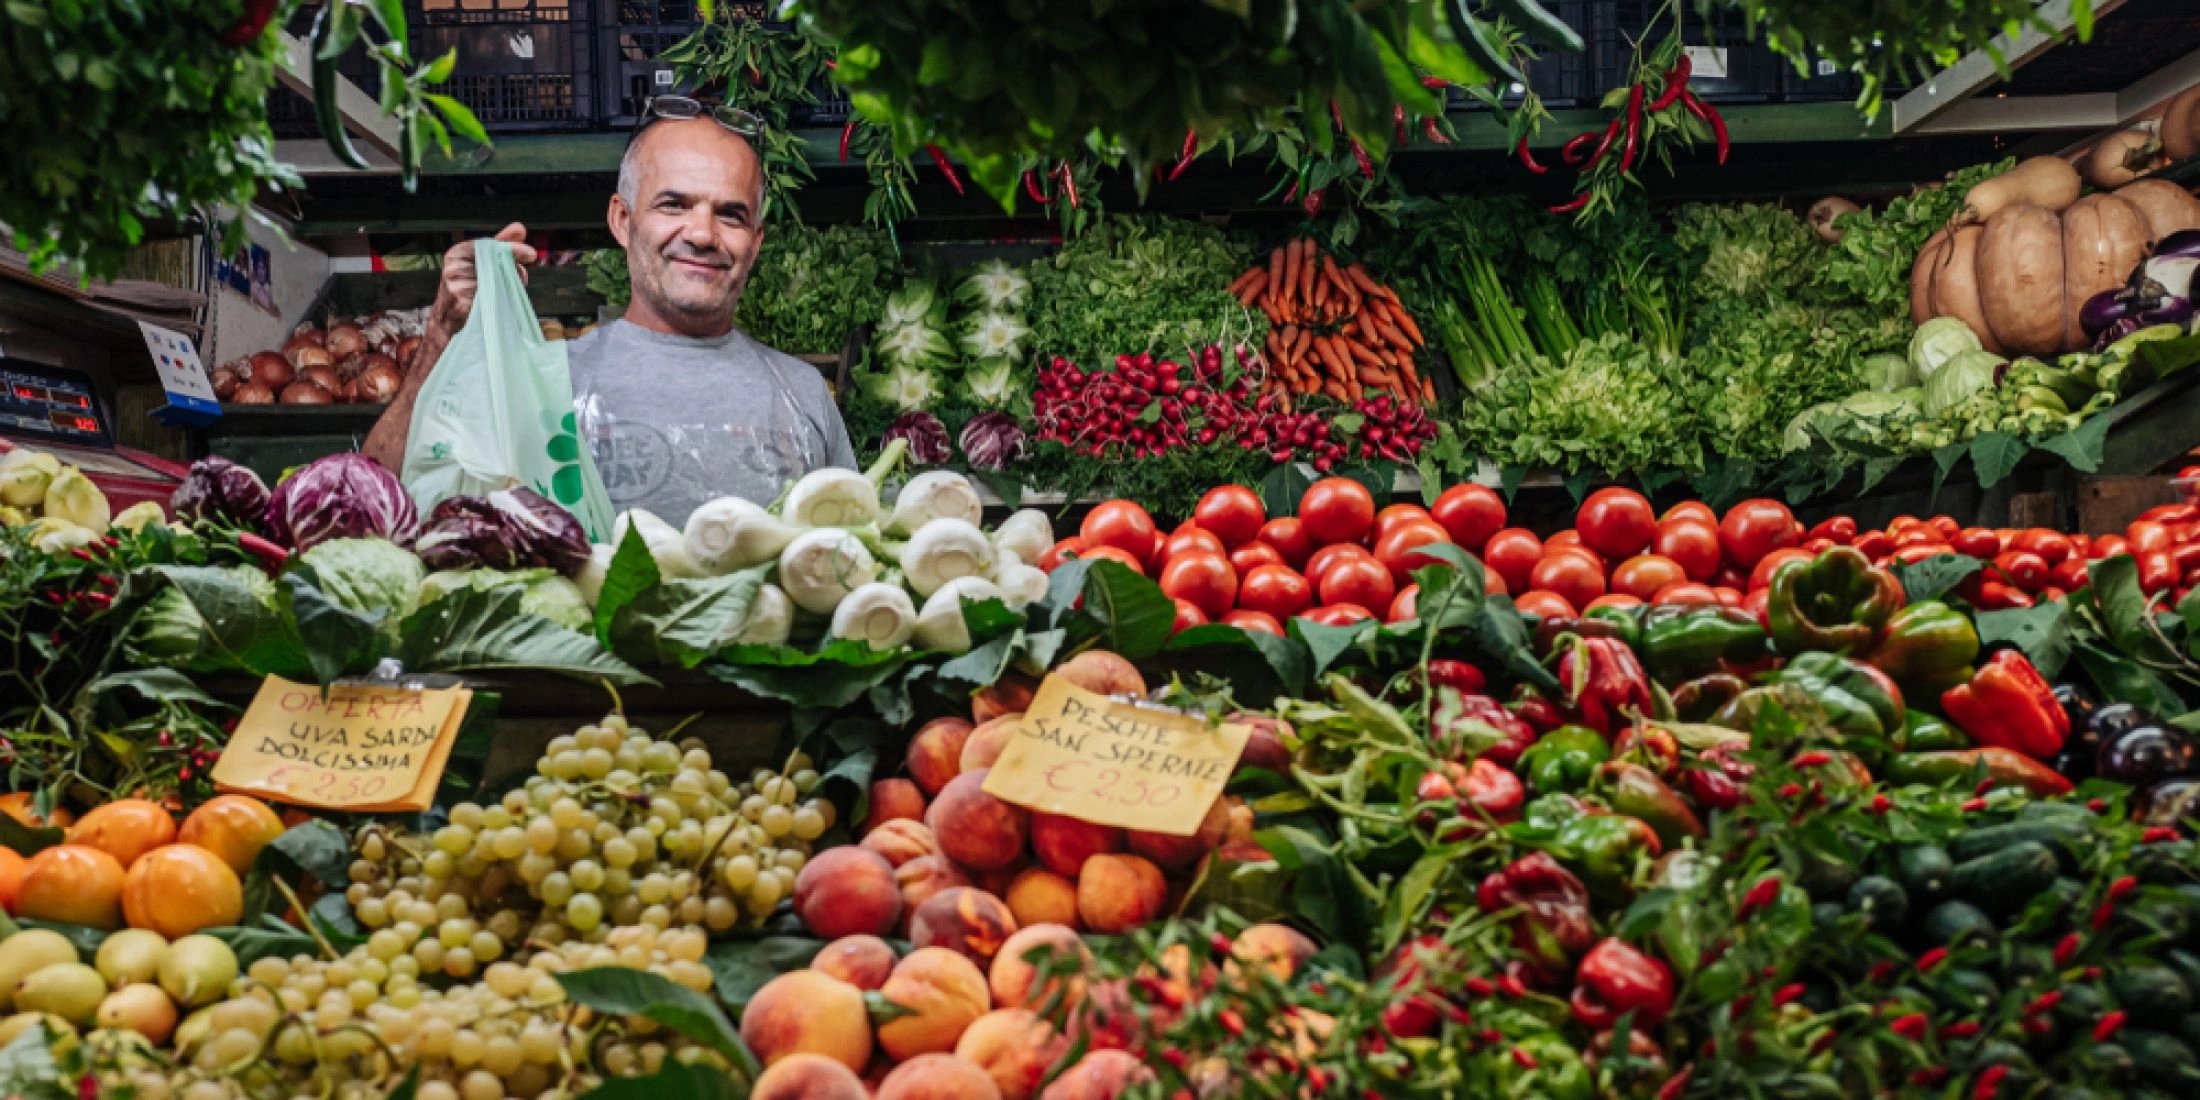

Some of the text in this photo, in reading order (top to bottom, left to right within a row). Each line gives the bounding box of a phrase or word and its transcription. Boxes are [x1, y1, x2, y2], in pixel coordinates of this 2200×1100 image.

[280, 688, 424, 720] OFFERTA
[289, 721, 349, 747] UVA
[1060, 696, 1170, 746] PESCHE
[255, 736, 410, 770] DOLCISSIMA
[1019, 719, 1229, 783] SAN SPERATE
[1045, 760, 1093, 793] €
